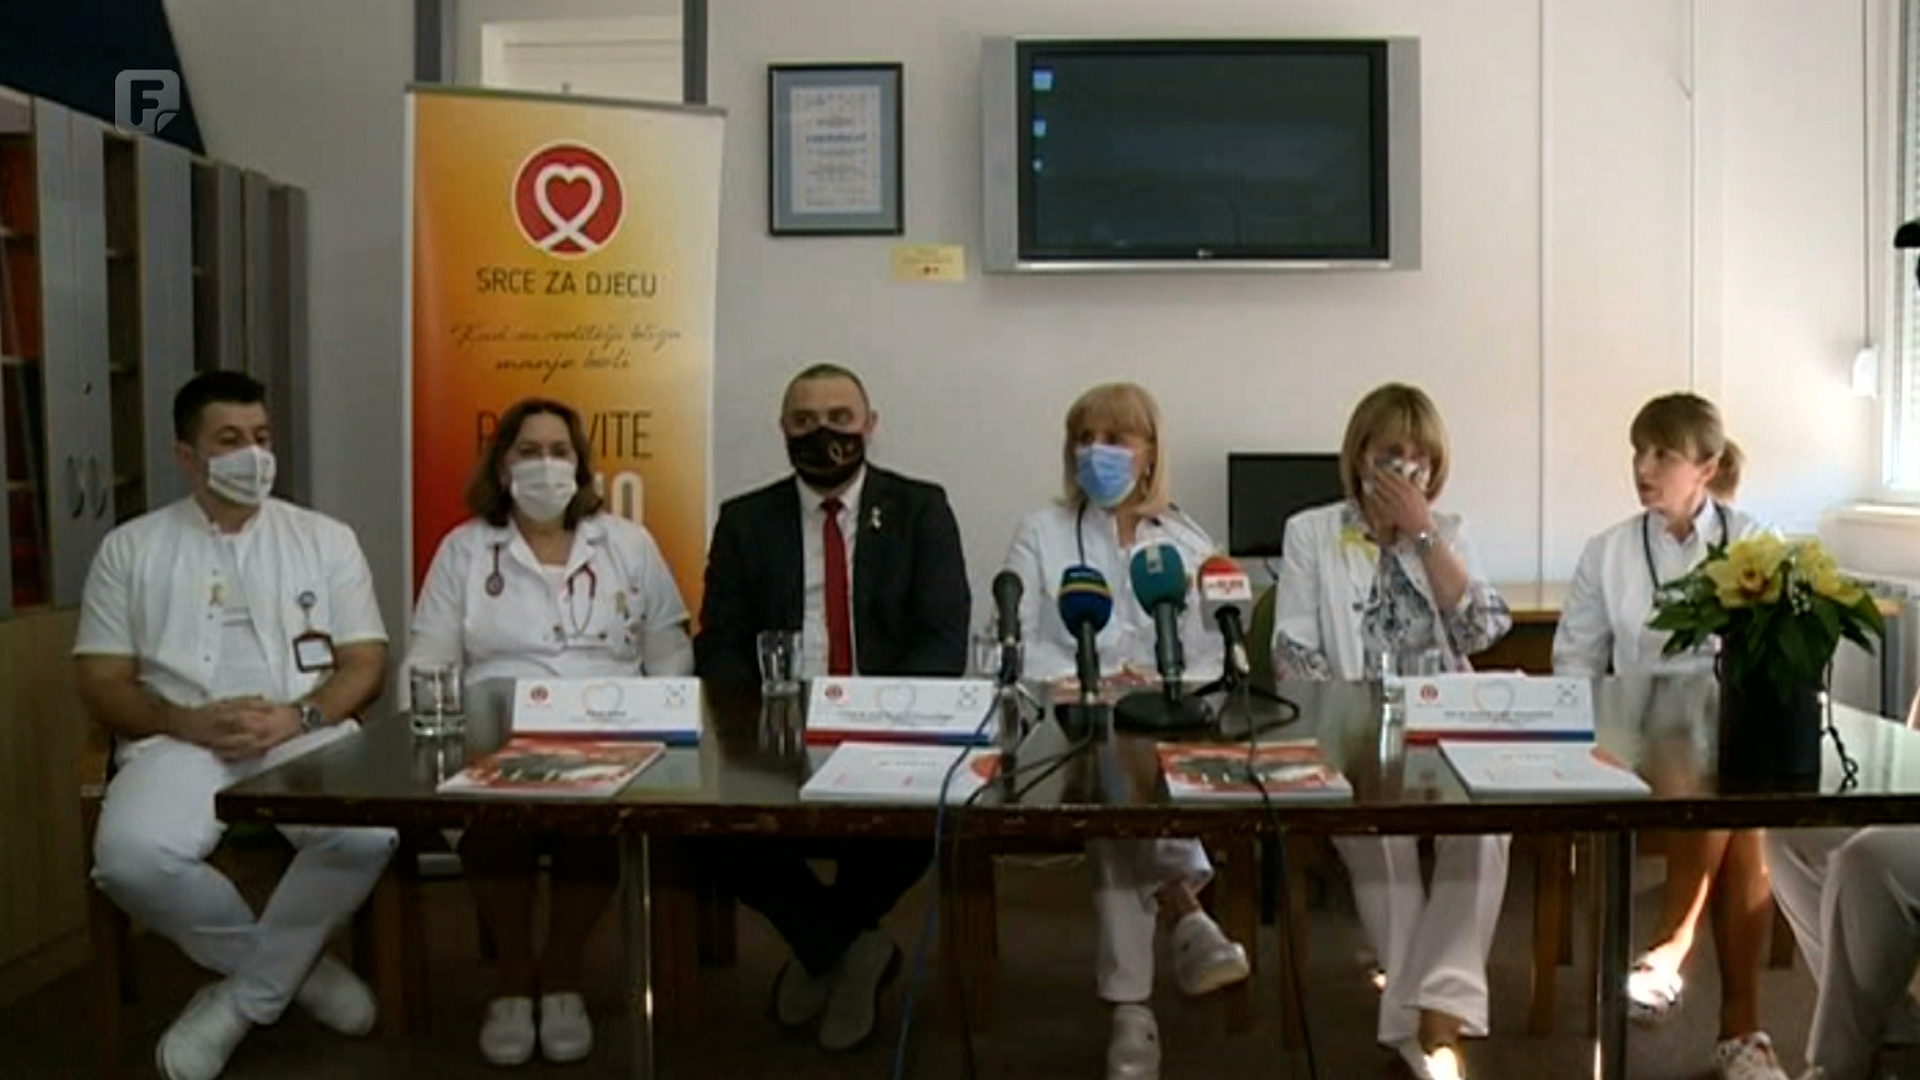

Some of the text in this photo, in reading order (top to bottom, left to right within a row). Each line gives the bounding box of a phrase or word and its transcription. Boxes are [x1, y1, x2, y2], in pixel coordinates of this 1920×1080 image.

[476, 268, 656, 299] SRCE ZA DJECU
